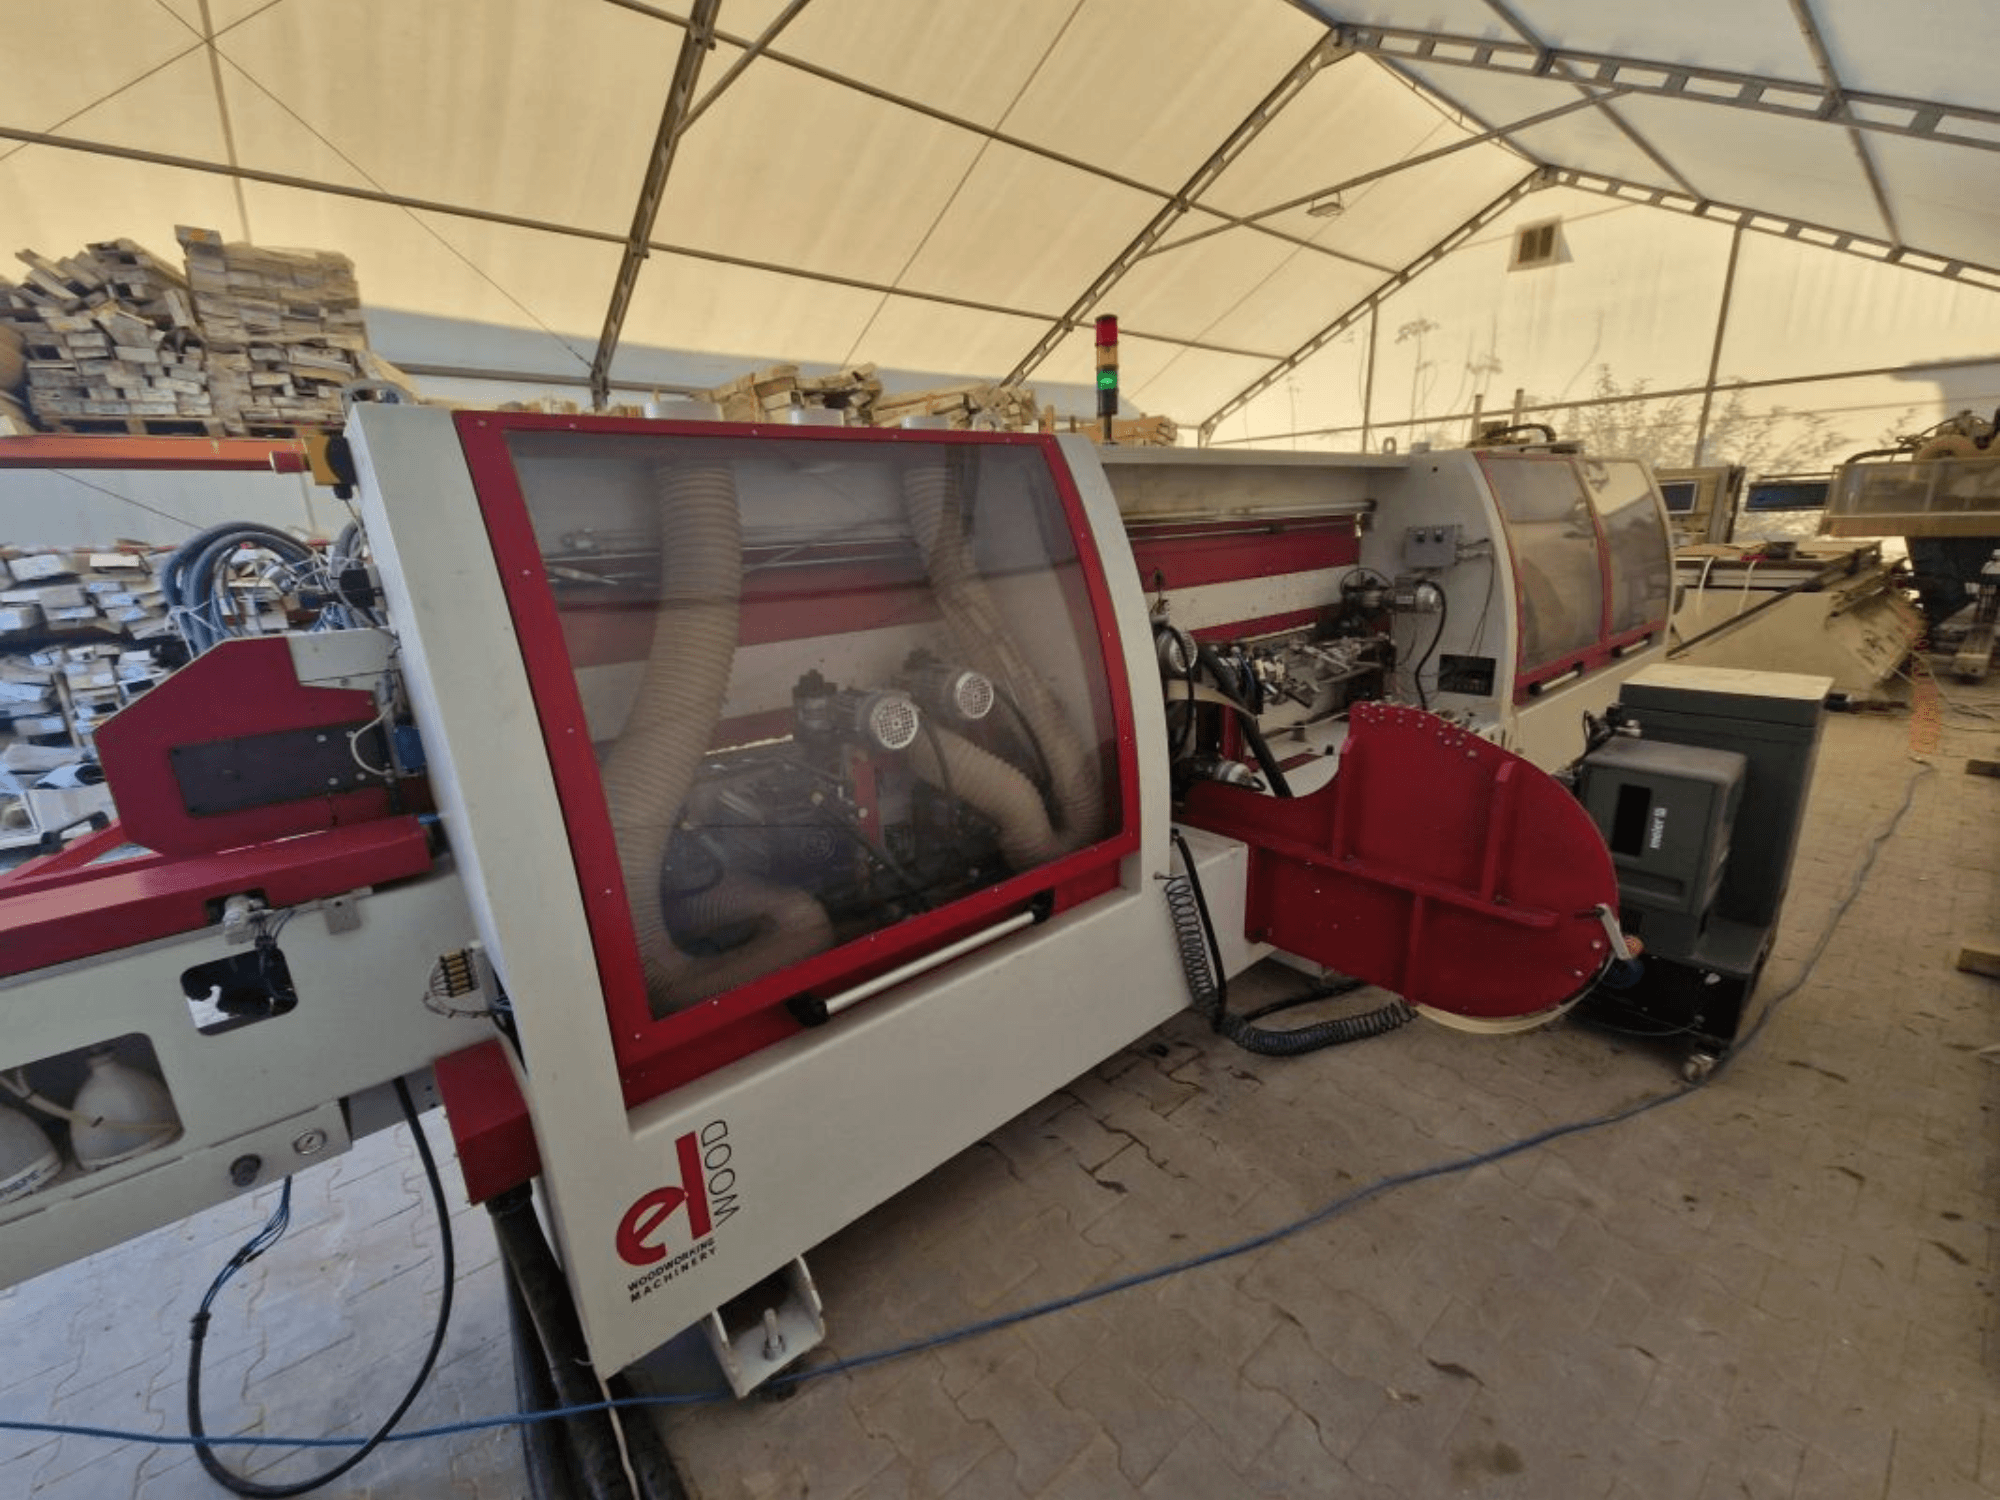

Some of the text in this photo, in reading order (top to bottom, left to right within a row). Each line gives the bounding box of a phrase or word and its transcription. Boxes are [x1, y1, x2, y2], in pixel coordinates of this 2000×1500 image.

[701, 1120, 740, 1228] WOOD
[627, 1237, 715, 1292] WOODWORKING
[631, 1247, 716, 1303] MACHINERY
